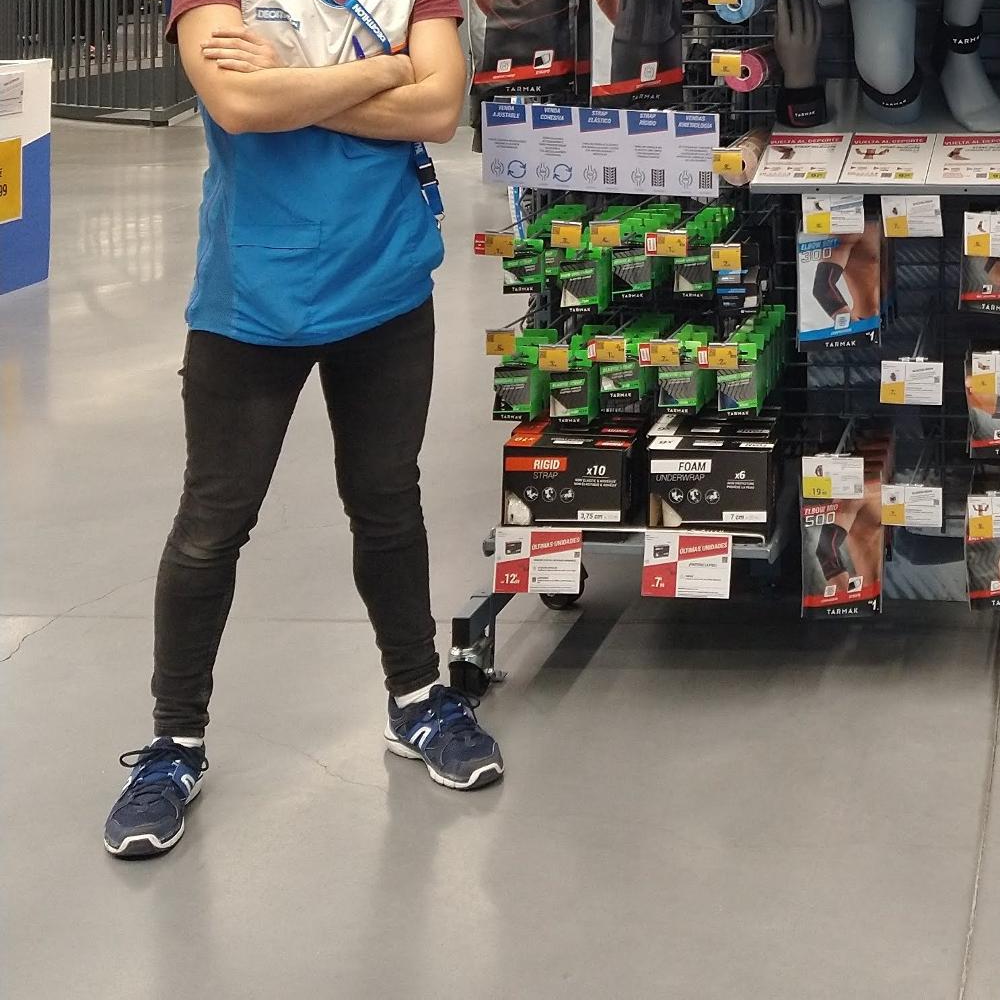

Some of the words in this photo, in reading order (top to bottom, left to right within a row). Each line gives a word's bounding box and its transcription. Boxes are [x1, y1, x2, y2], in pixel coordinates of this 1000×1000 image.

[352, 3, 387, 43] DECATHLON
[801, 248, 832, 264] 300
[825, 340, 856, 348] TARMAK
[533, 459, 560, 470] RIGID
[679, 461, 706, 471] FOAM
[586, 465, 606, 476] x10
[734, 470, 746, 480] x6
[533, 472, 558, 480] STRAP
[656, 473, 705, 482] UNDERWRAP
[804, 512, 836, 527] 500
[826, 608, 858, 616] TARMAK
